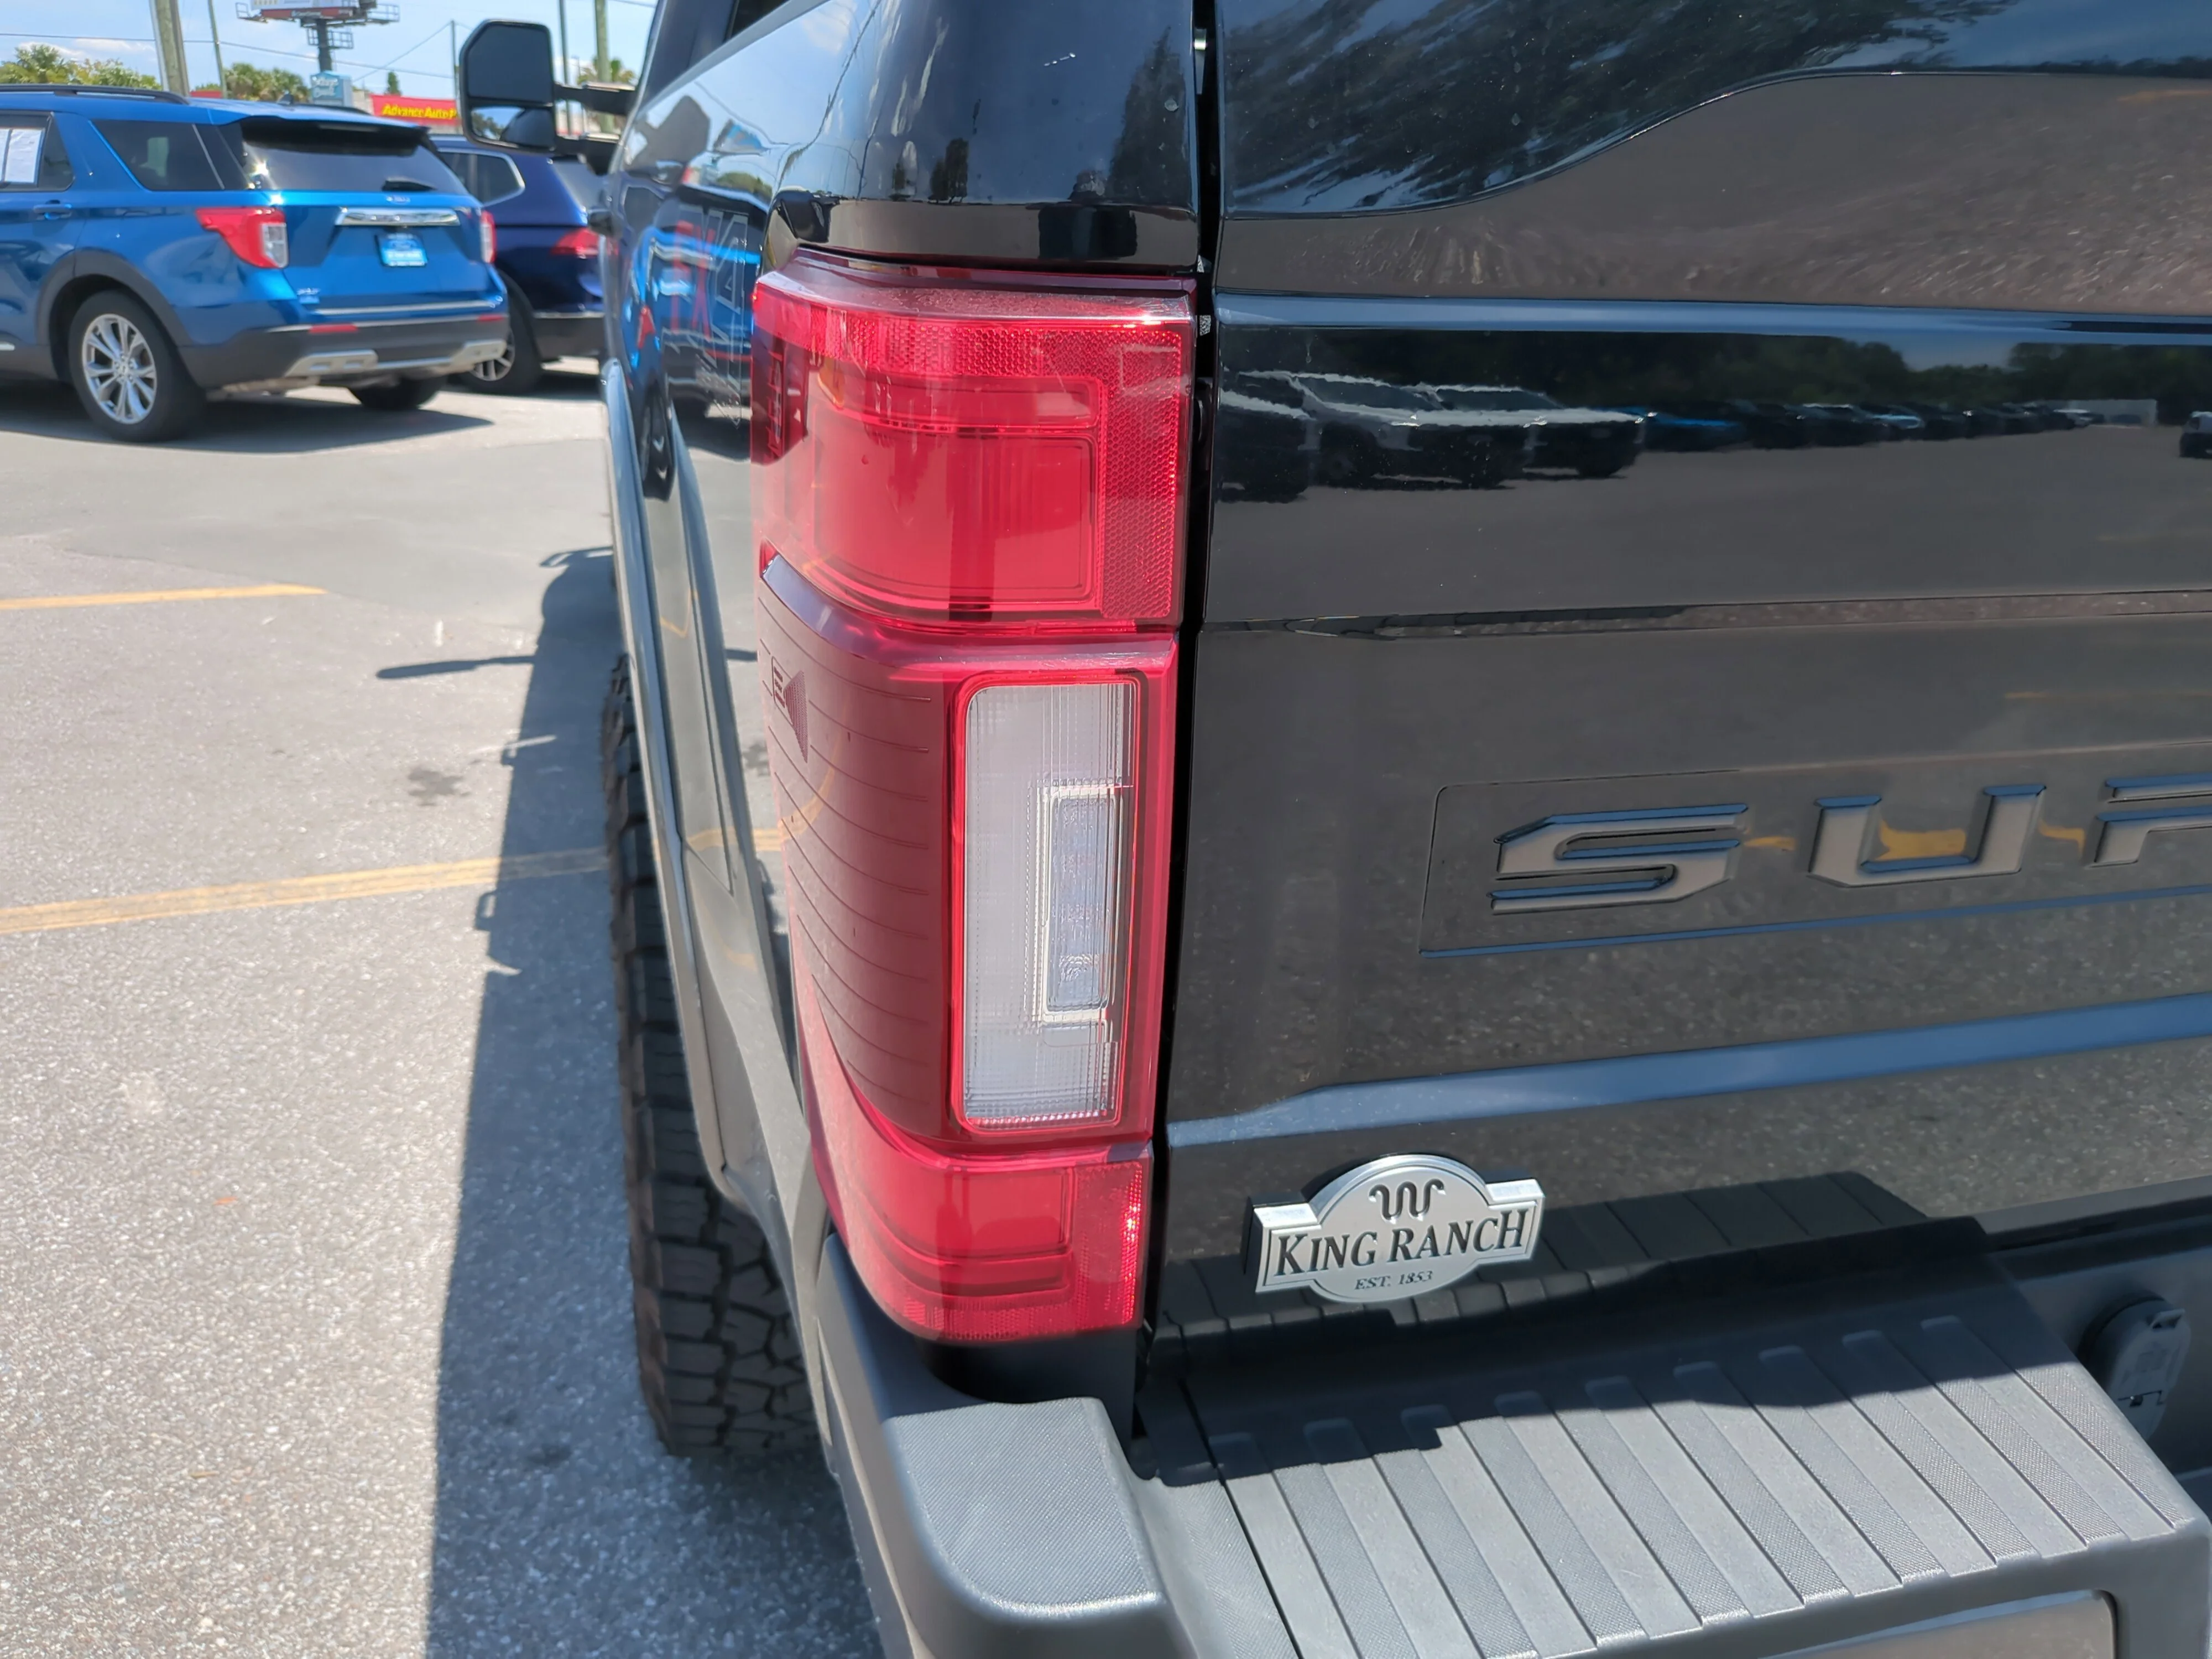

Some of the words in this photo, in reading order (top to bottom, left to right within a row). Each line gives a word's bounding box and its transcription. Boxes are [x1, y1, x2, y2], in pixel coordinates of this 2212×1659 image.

[383, 103, 424, 117] Advance
[425, 106, 449, 118] Auto
[1274, 1230, 1378, 1276] KING
[1386, 1208, 1528, 1262] RANCH
[1355, 1275, 1391, 1290] EST.
[1398, 1271, 1433, 1285] 1853
